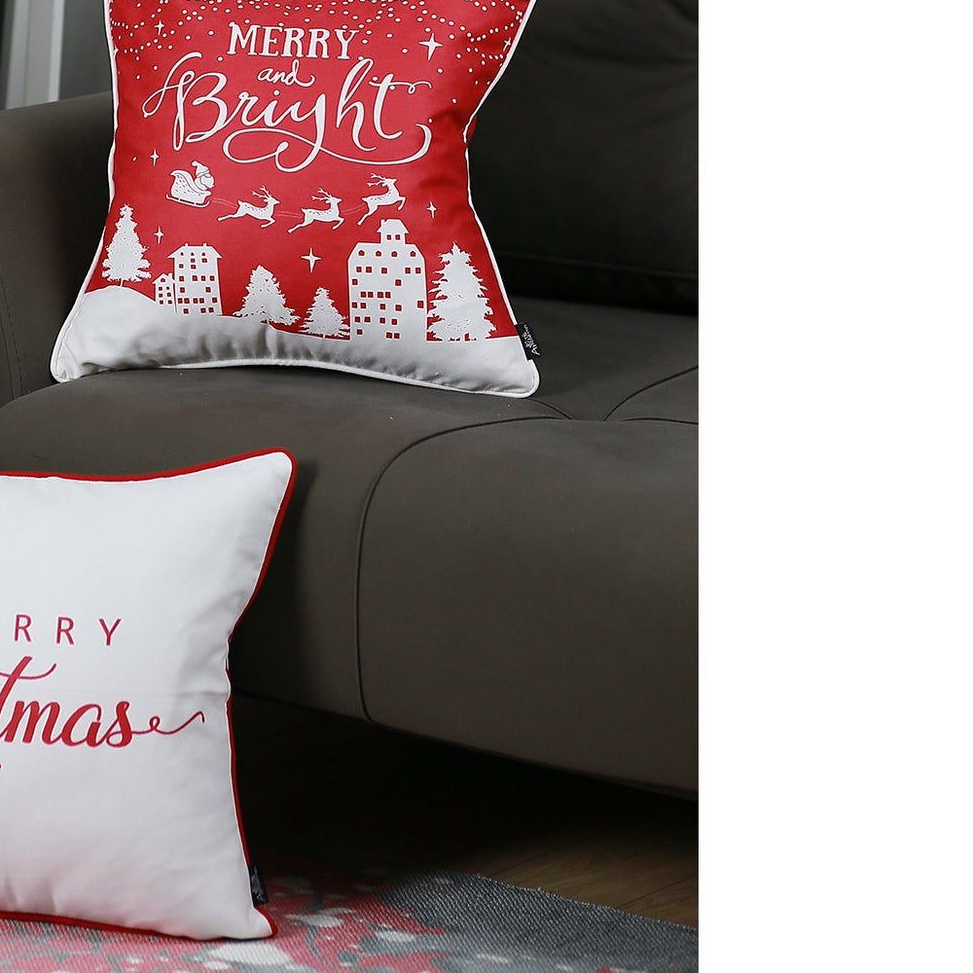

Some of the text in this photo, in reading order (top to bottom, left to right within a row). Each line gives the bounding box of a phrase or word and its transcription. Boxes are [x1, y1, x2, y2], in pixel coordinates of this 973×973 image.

[226, 23, 359, 61] MERRY
[257, 59, 315, 88] and
[142, 51, 433, 173] Bright
